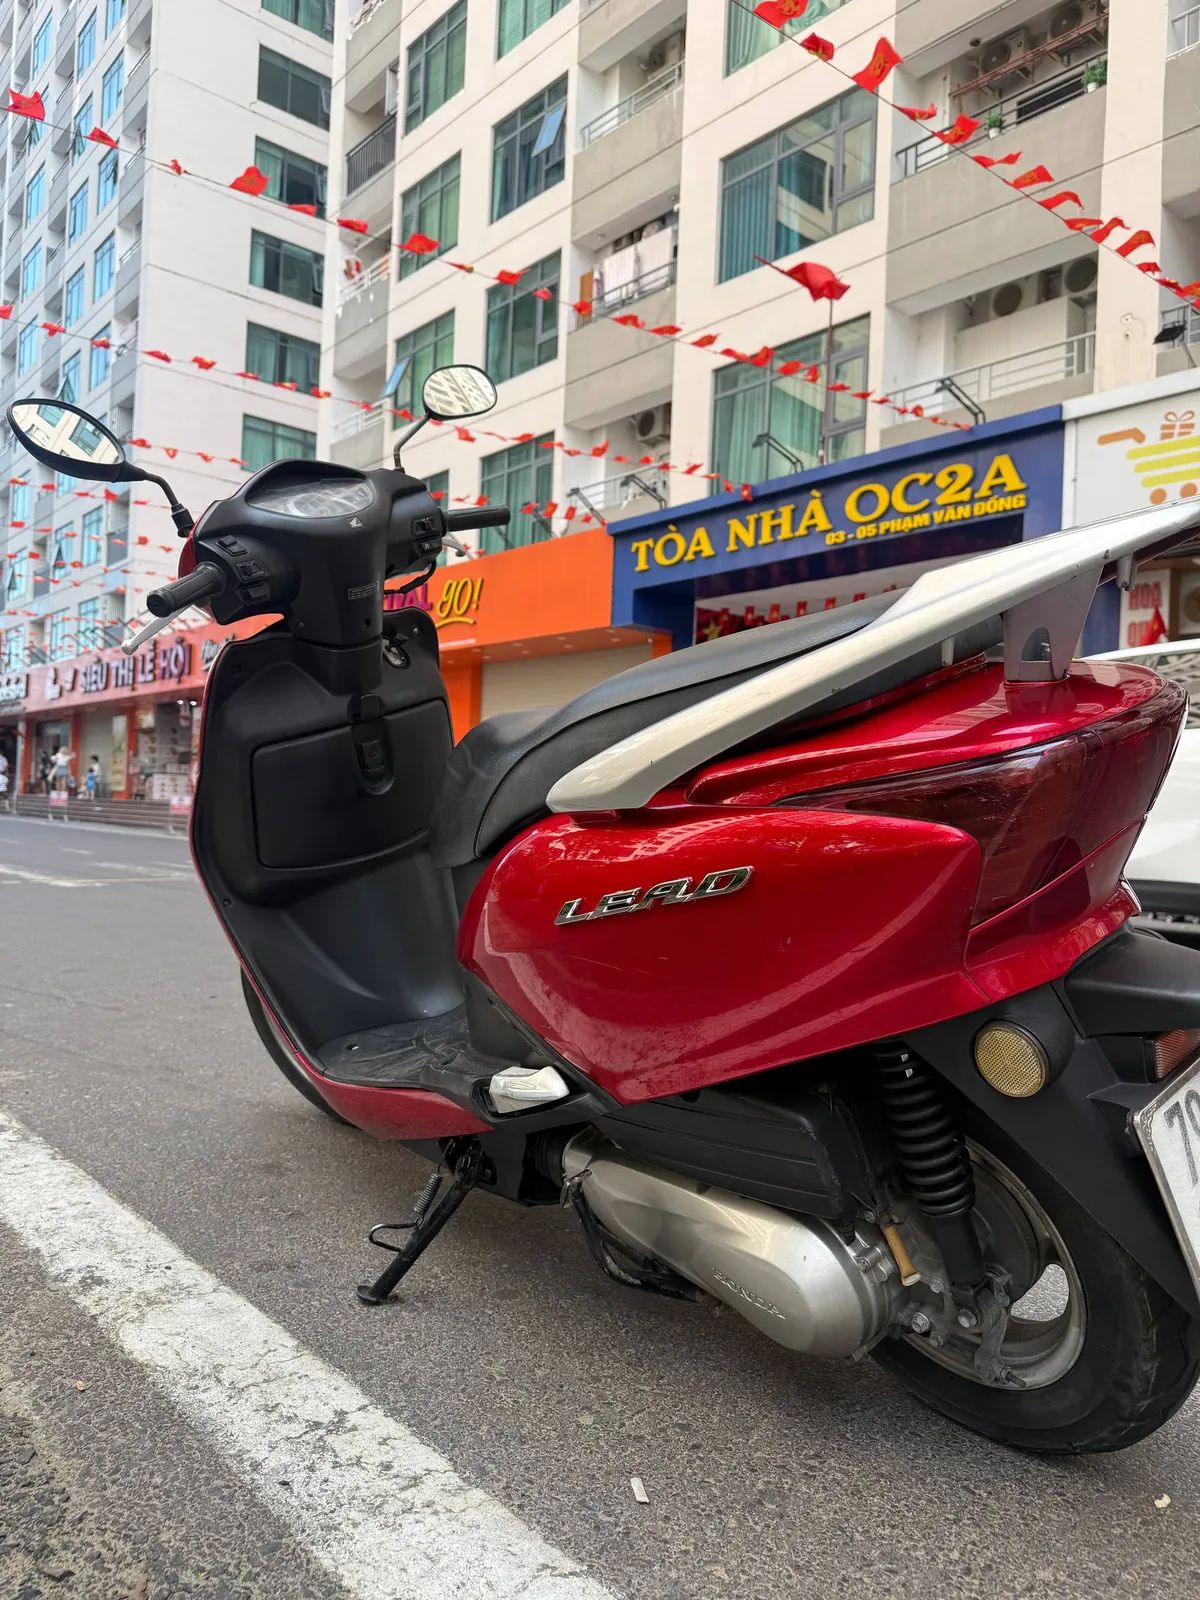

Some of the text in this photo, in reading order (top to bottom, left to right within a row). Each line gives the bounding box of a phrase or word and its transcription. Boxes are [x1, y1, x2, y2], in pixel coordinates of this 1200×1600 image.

[631, 453, 1026, 573] TÒA NHÀ OC2A
[825, 531, 846, 545] 03
[856, 524, 877, 540] 05
[879, 513, 930, 535] PHẠM
[933, 505, 971, 525] VĂN
[111, 657, 134, 691] THỊ
[554, 865, 754, 926] LEAD
[711, 1266, 786, 1320] HONDA
